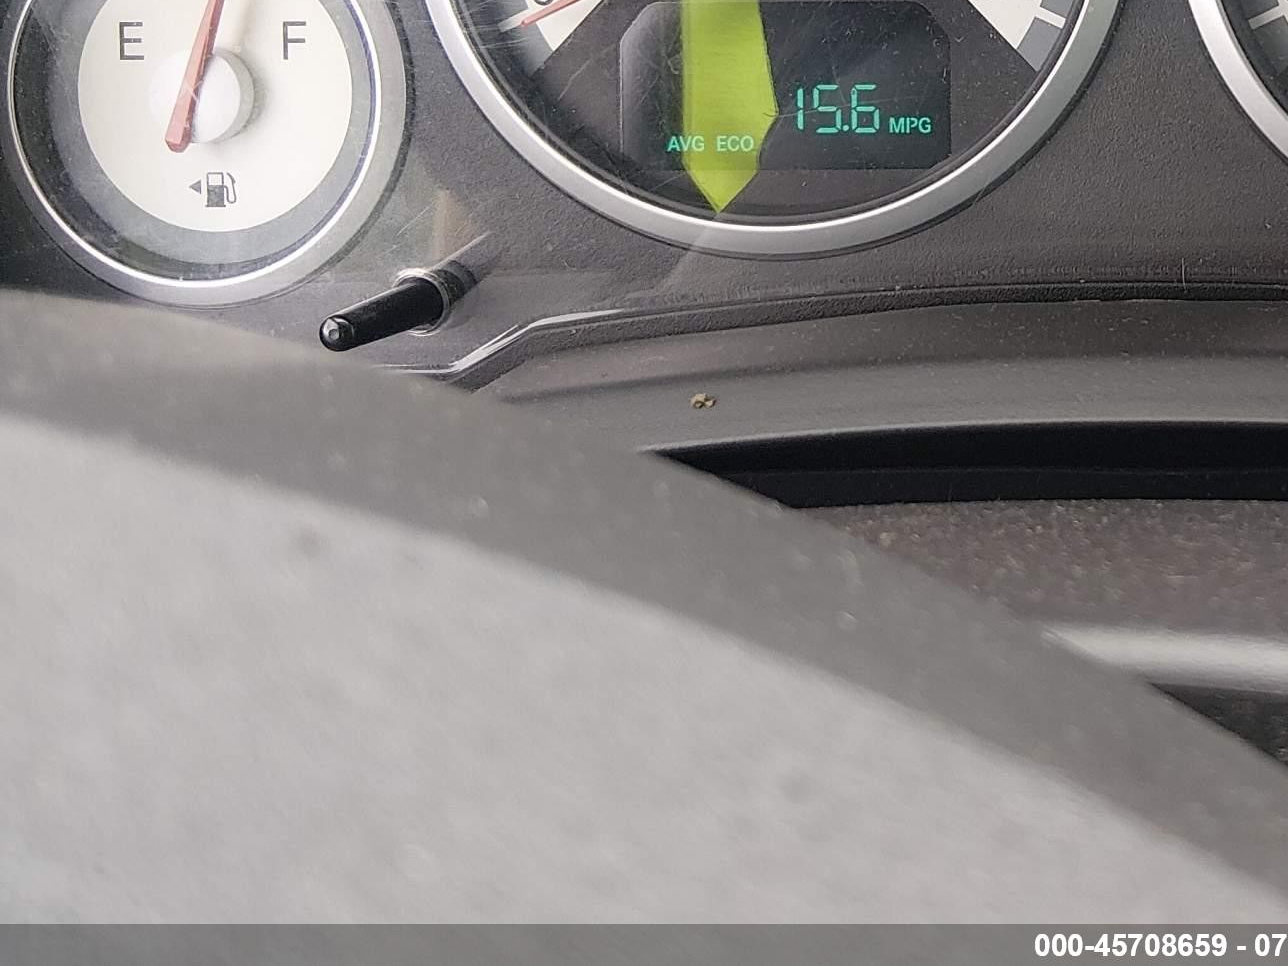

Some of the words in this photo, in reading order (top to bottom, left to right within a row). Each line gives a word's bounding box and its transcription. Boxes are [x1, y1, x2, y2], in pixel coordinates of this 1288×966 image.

[119, 22, 144, 60] E
[283, 21, 306, 60] F
[797, 84, 880, 134] 15.6
[889, 117, 931, 134] MPG
[667, 136, 705, 152] AVG
[716, 136, 755, 152] ECO
